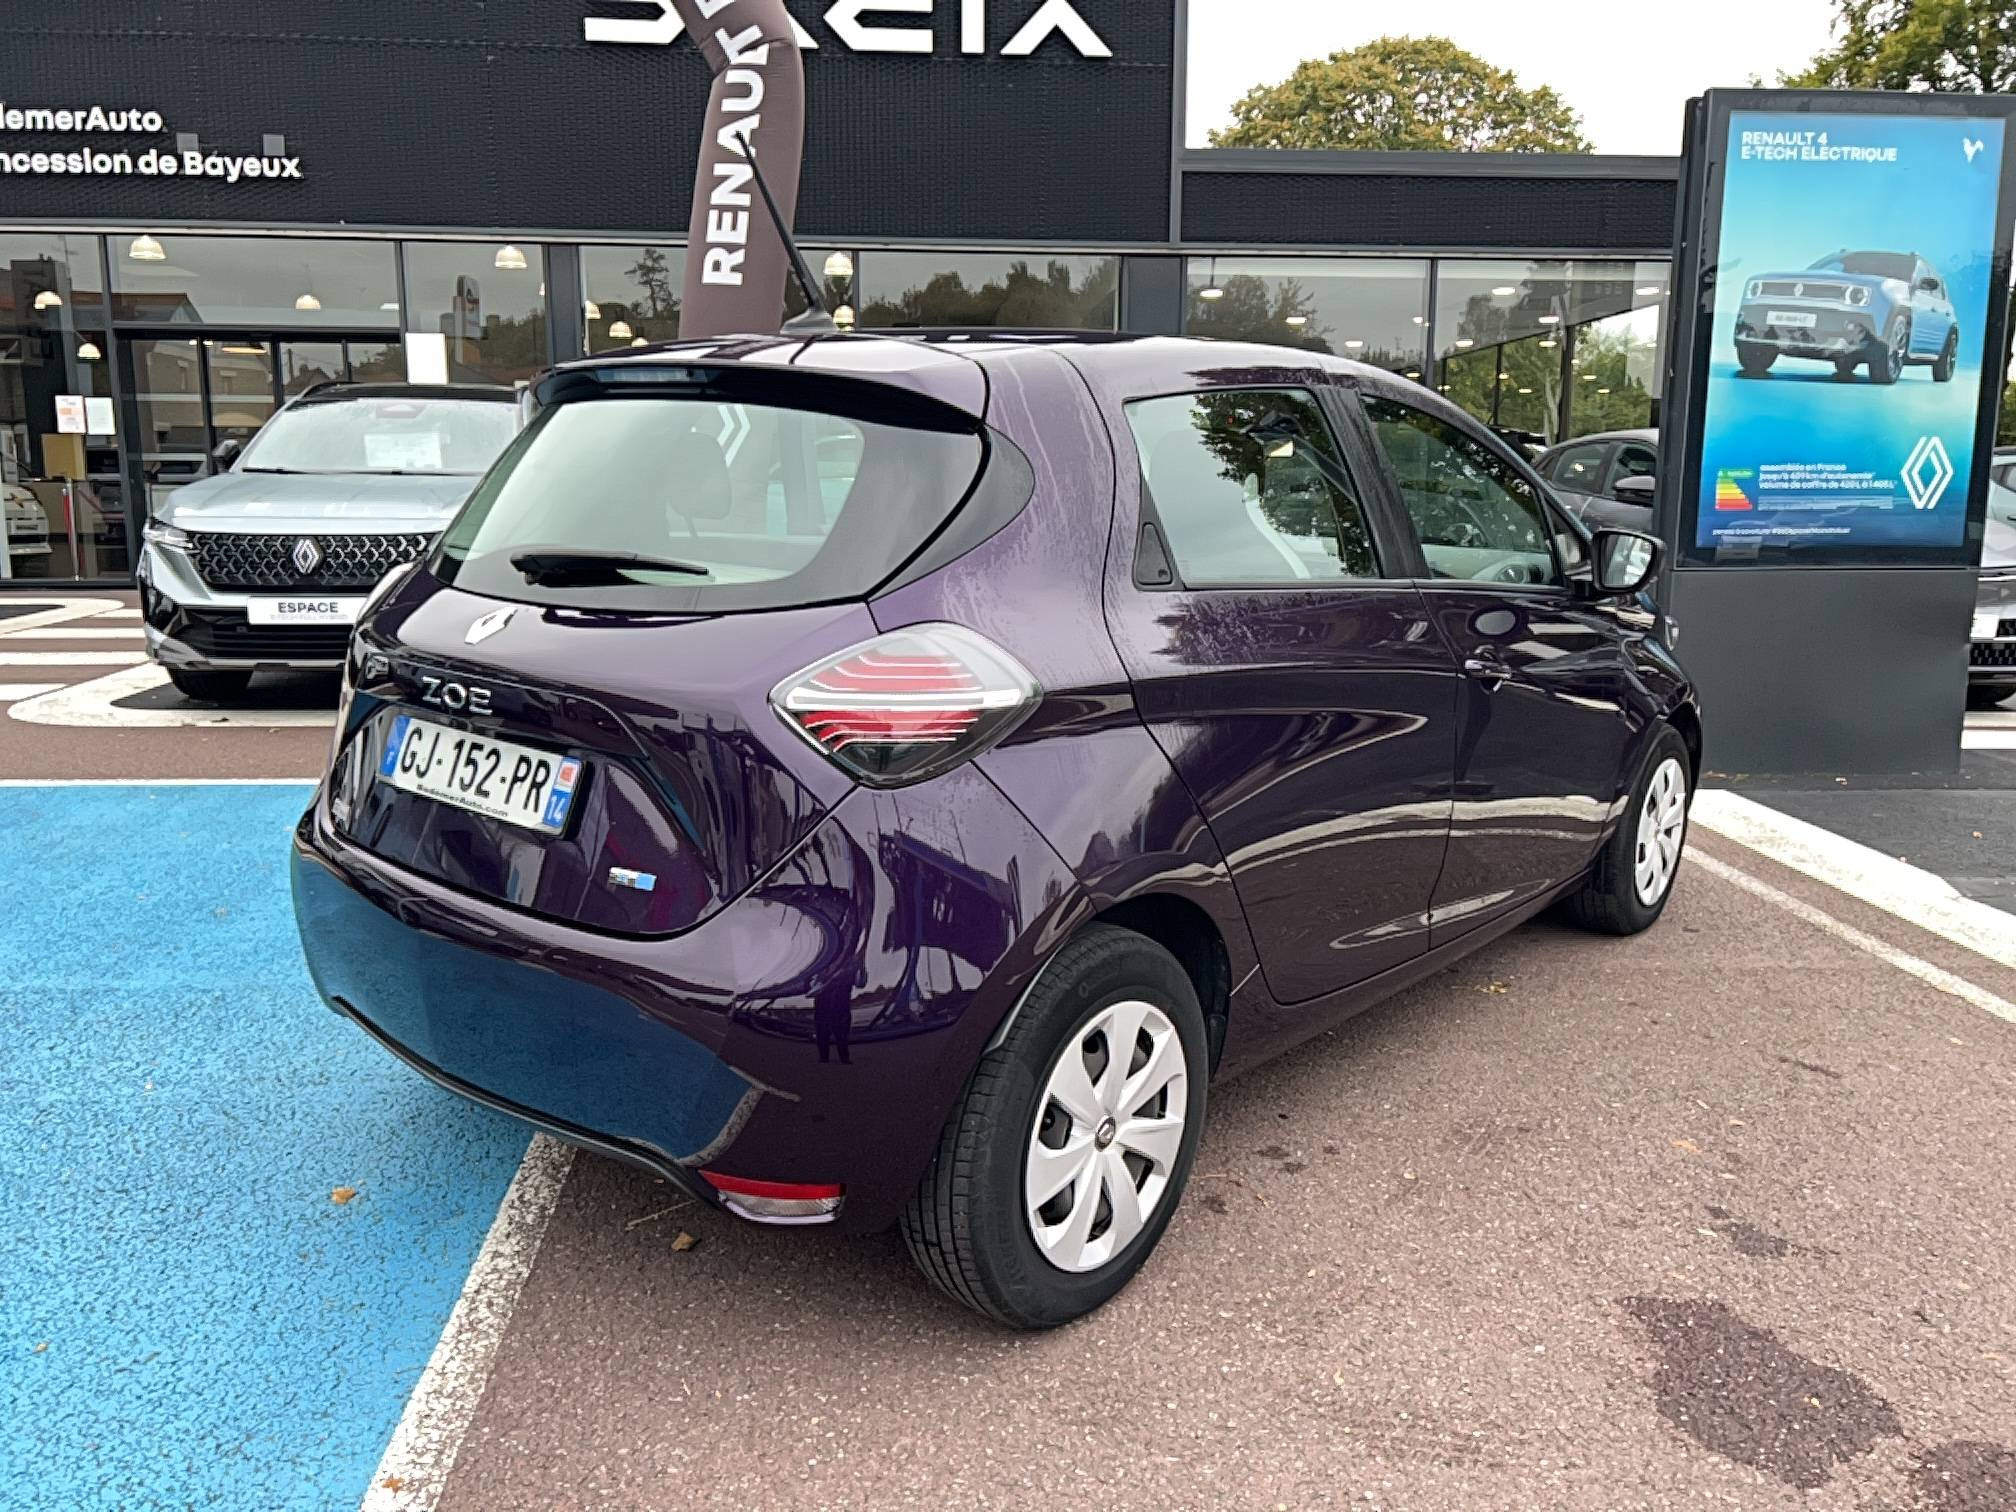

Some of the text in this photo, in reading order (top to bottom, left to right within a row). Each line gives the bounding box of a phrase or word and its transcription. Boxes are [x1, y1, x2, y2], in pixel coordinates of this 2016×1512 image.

[0, 102, 163, 132] emerAuto
[1741, 146, 1798, 160] E-TECH
[1742, 131, 1828, 145] RENAULT 4
[138, 149, 178, 175] de
[182, 151, 302, 183] Bayeux
[278, 602, 338, 613] ESPACE
[422, 676, 493, 715] ZOE
[400, 727, 551, 813] GJ-152-PR
[546, 794, 566, 823] 14
